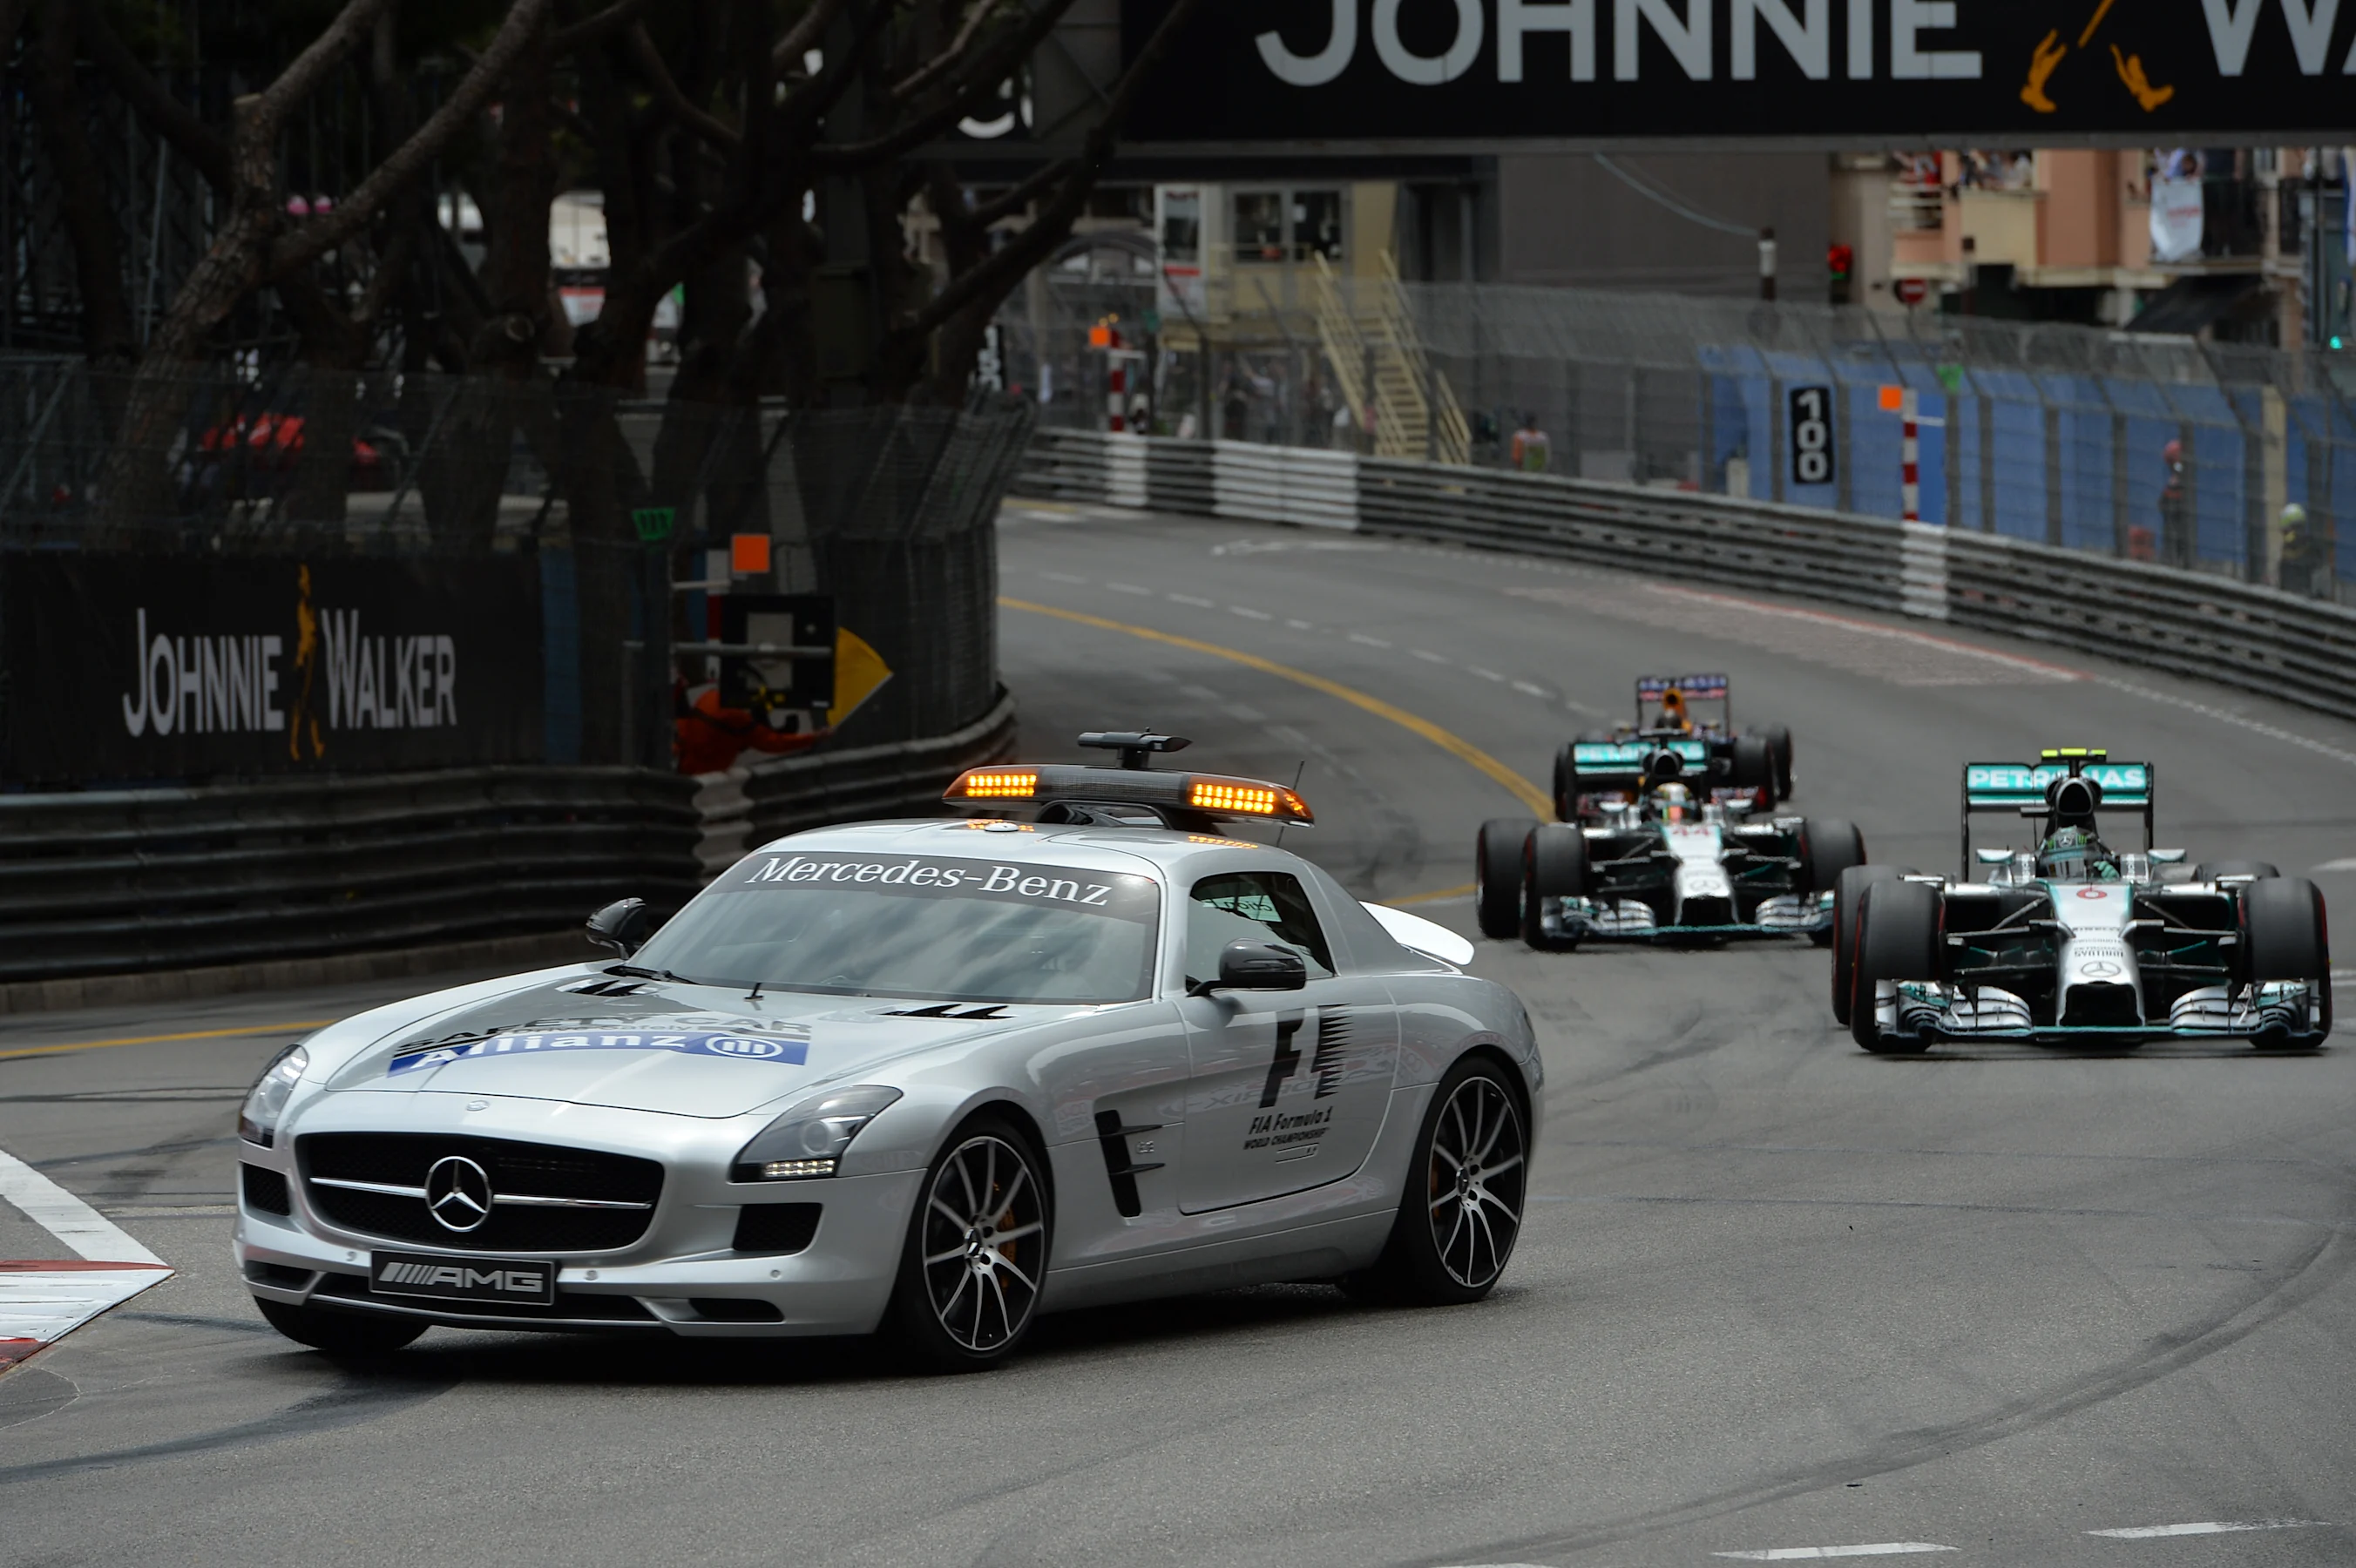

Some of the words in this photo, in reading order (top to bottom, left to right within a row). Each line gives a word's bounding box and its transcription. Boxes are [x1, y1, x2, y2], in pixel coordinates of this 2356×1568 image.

[1797, 389, 1828, 482] 100
[122, 607, 285, 738] JOHNNIE
[321, 608, 457, 730] WALKER
[744, 856, 1113, 906] Mercedes-Benz
[674, 1017, 812, 1034] CAR
[410, 1034, 687, 1069] Allianz
[1249, 1115, 1272, 1134] FIA
[1273, 1110, 1324, 1131] Formula
[1324, 1105, 1333, 1123] 1
[1243, 1137, 1270, 1149] WORLD
